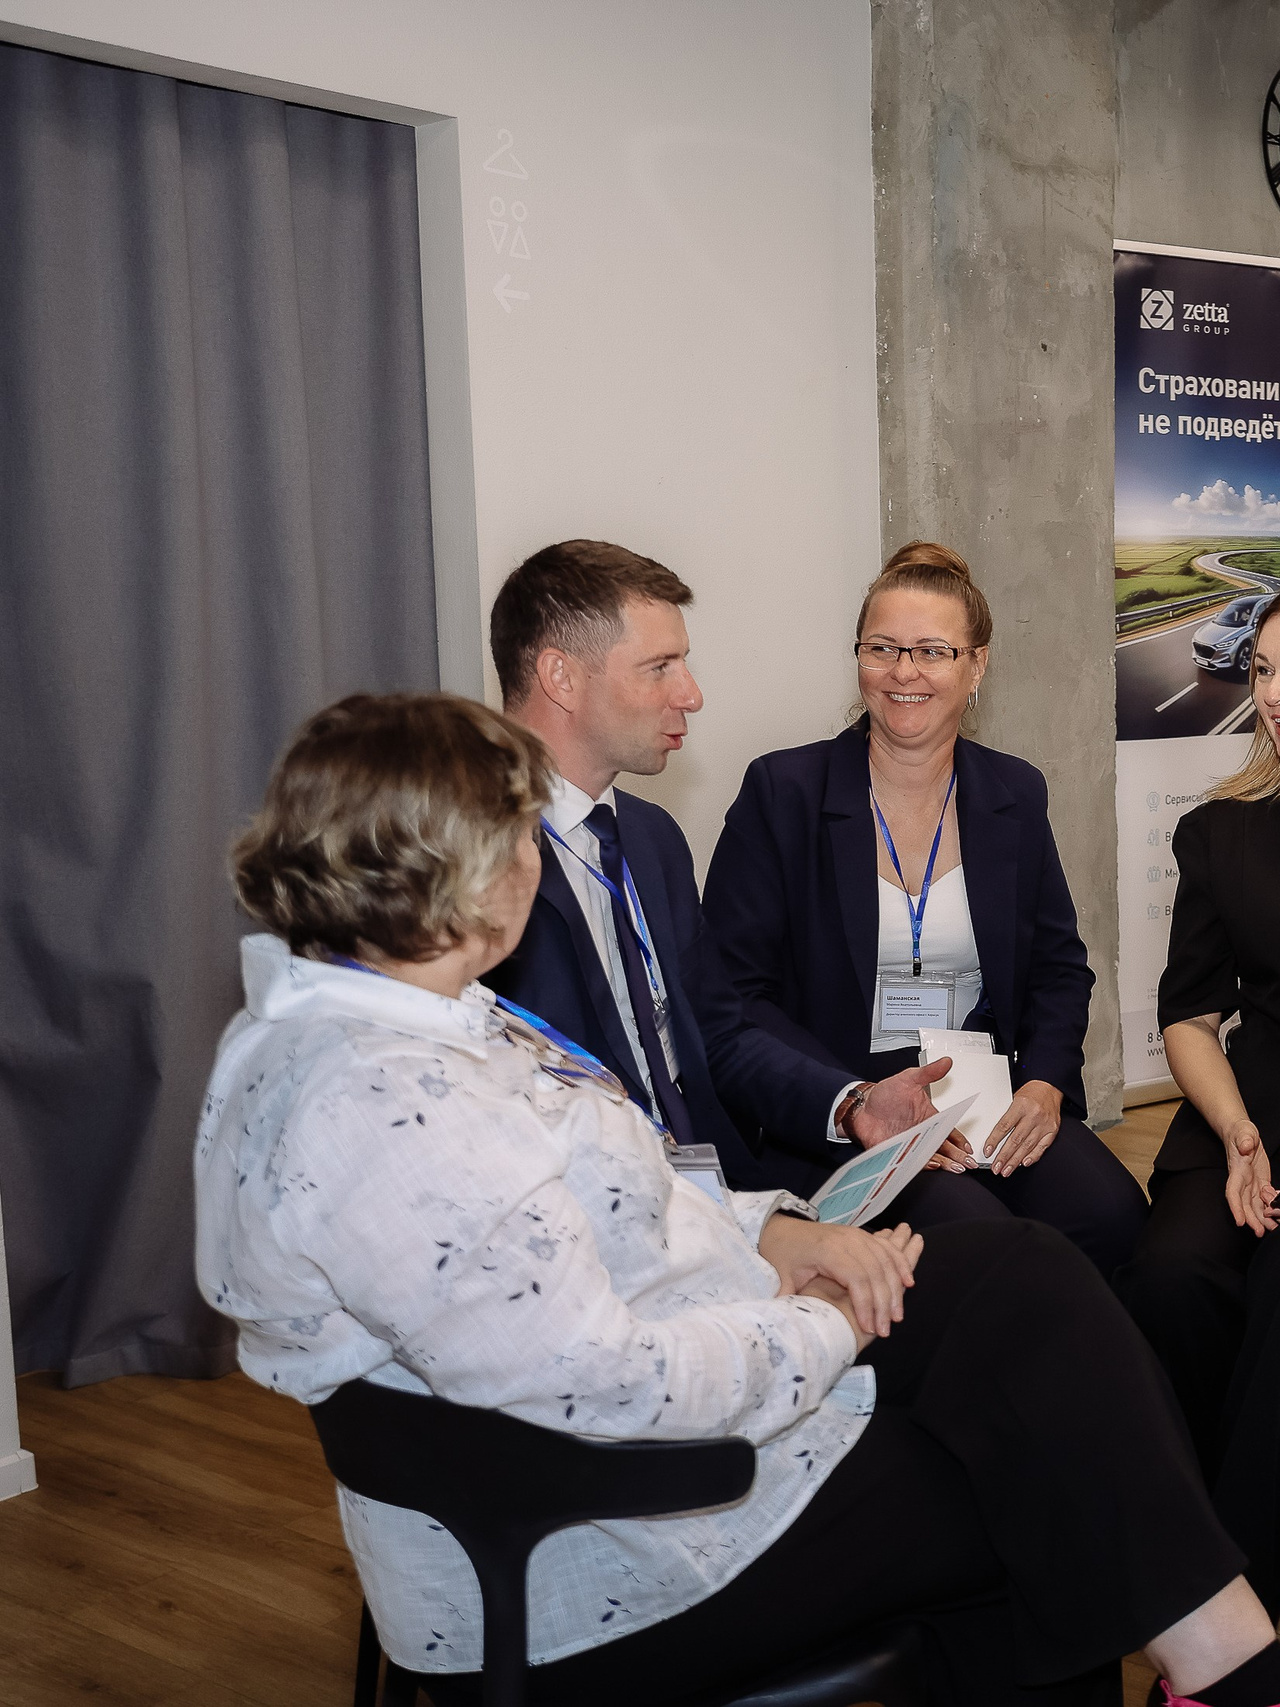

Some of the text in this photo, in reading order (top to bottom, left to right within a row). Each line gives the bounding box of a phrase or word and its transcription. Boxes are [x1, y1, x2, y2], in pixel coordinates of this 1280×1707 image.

[1183, 302, 1230, 323] zetta
[1183, 324, 1230, 336] GROUP
[1138, 413, 1171, 435] не
[1147, 1032, 1154, 1043] 8
